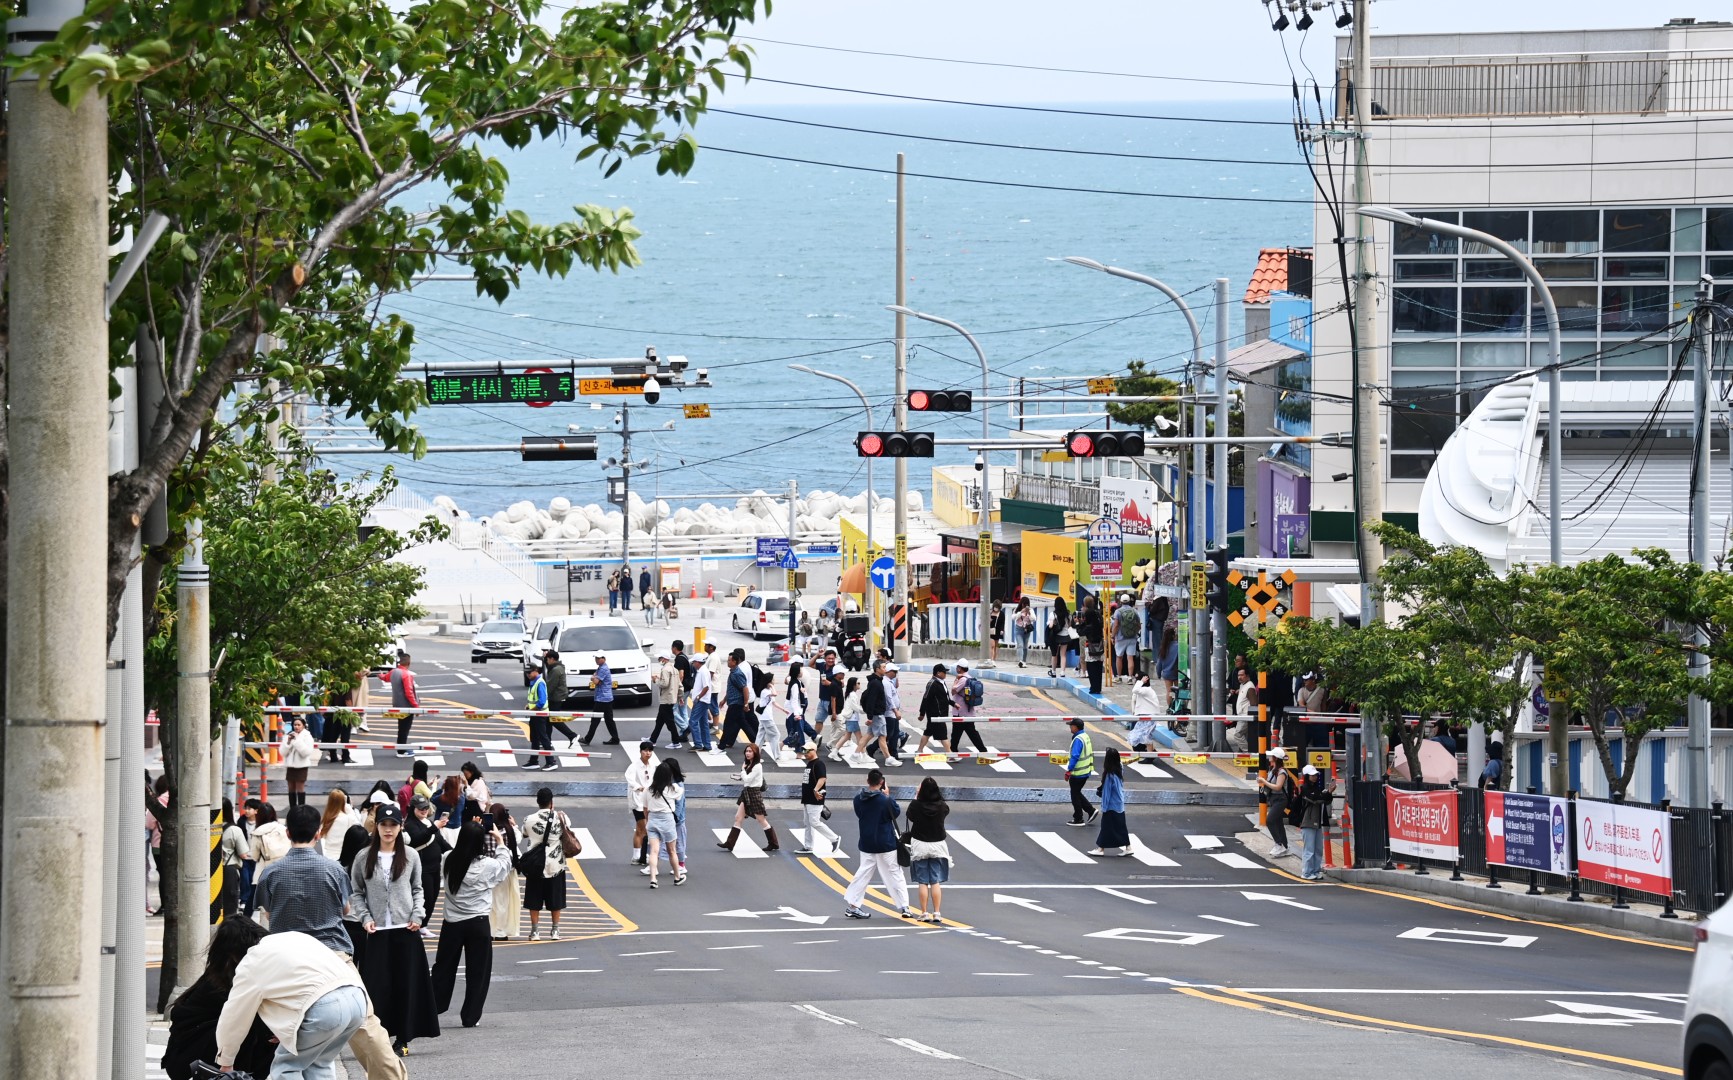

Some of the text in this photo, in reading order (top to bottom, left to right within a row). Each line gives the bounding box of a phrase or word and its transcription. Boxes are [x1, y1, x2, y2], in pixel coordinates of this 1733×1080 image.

[558, 377, 571, 396] 주
[1240, 579, 1249, 589] 멈
[1274, 579, 1283, 589] 멈
[1241, 606, 1249, 616] 춤
[1275, 606, 1284, 615] 춤
[1402, 805, 1440, 829] 차도 무단 진입 금지
